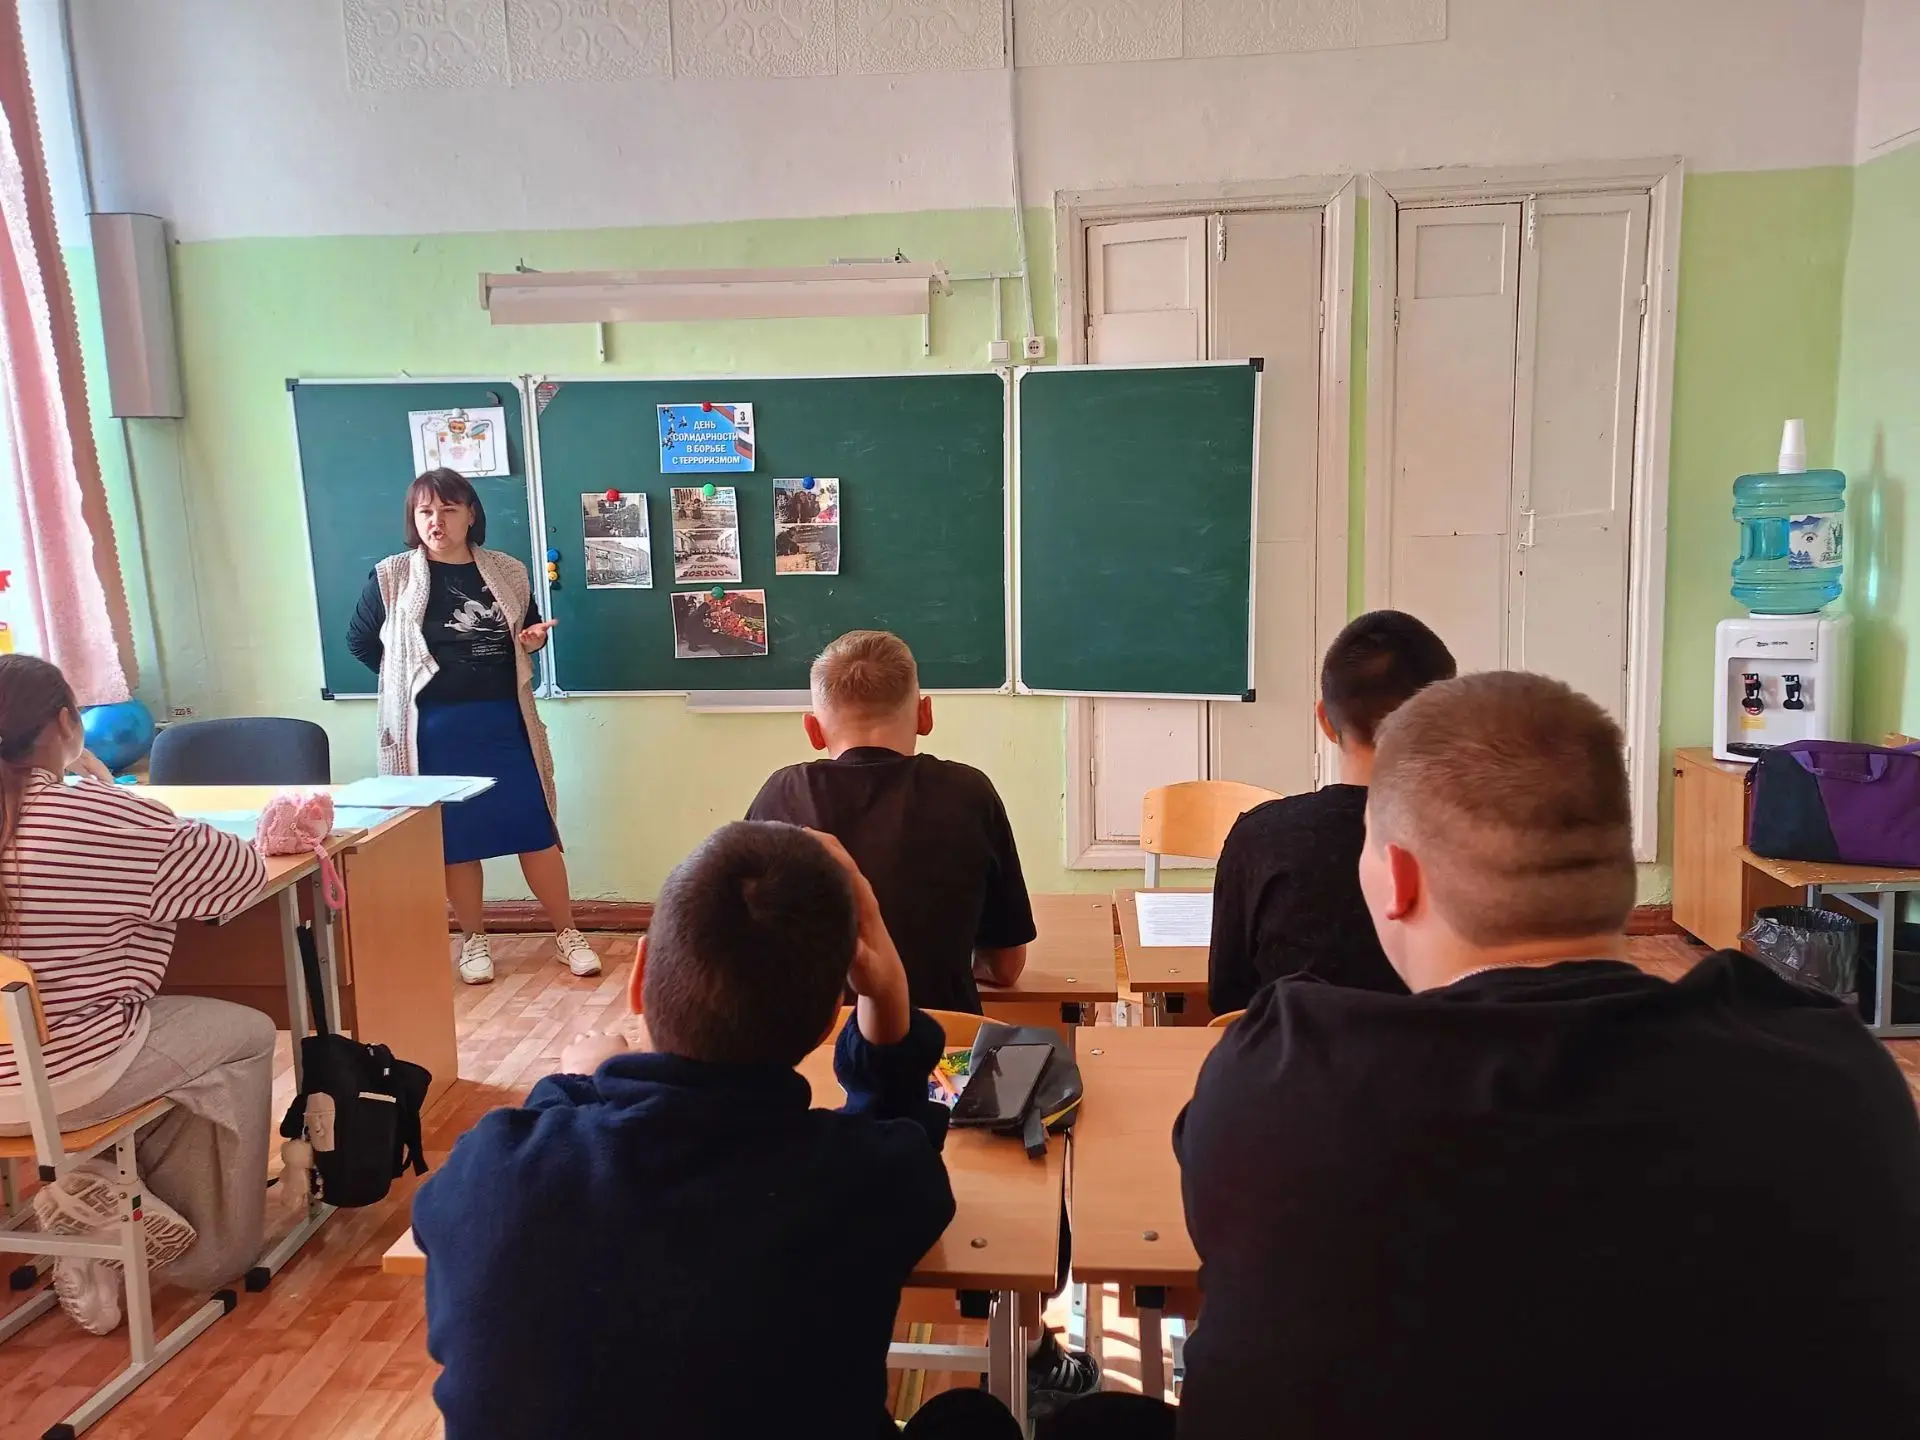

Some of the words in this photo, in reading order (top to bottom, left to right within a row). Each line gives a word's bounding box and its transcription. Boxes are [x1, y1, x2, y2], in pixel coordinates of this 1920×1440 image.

[740, 411, 746, 421] 3
[693, 420, 717, 430] ДЕНЬ
[672, 432, 739, 442] СОЛИДАРНОСТИ
[686, 444, 693, 453] В
[694, 444, 726, 453] БОРЬБЕ
[672, 456, 678, 465] С
[679, 455, 741, 465] ТЕРРОРИЗМОМ
